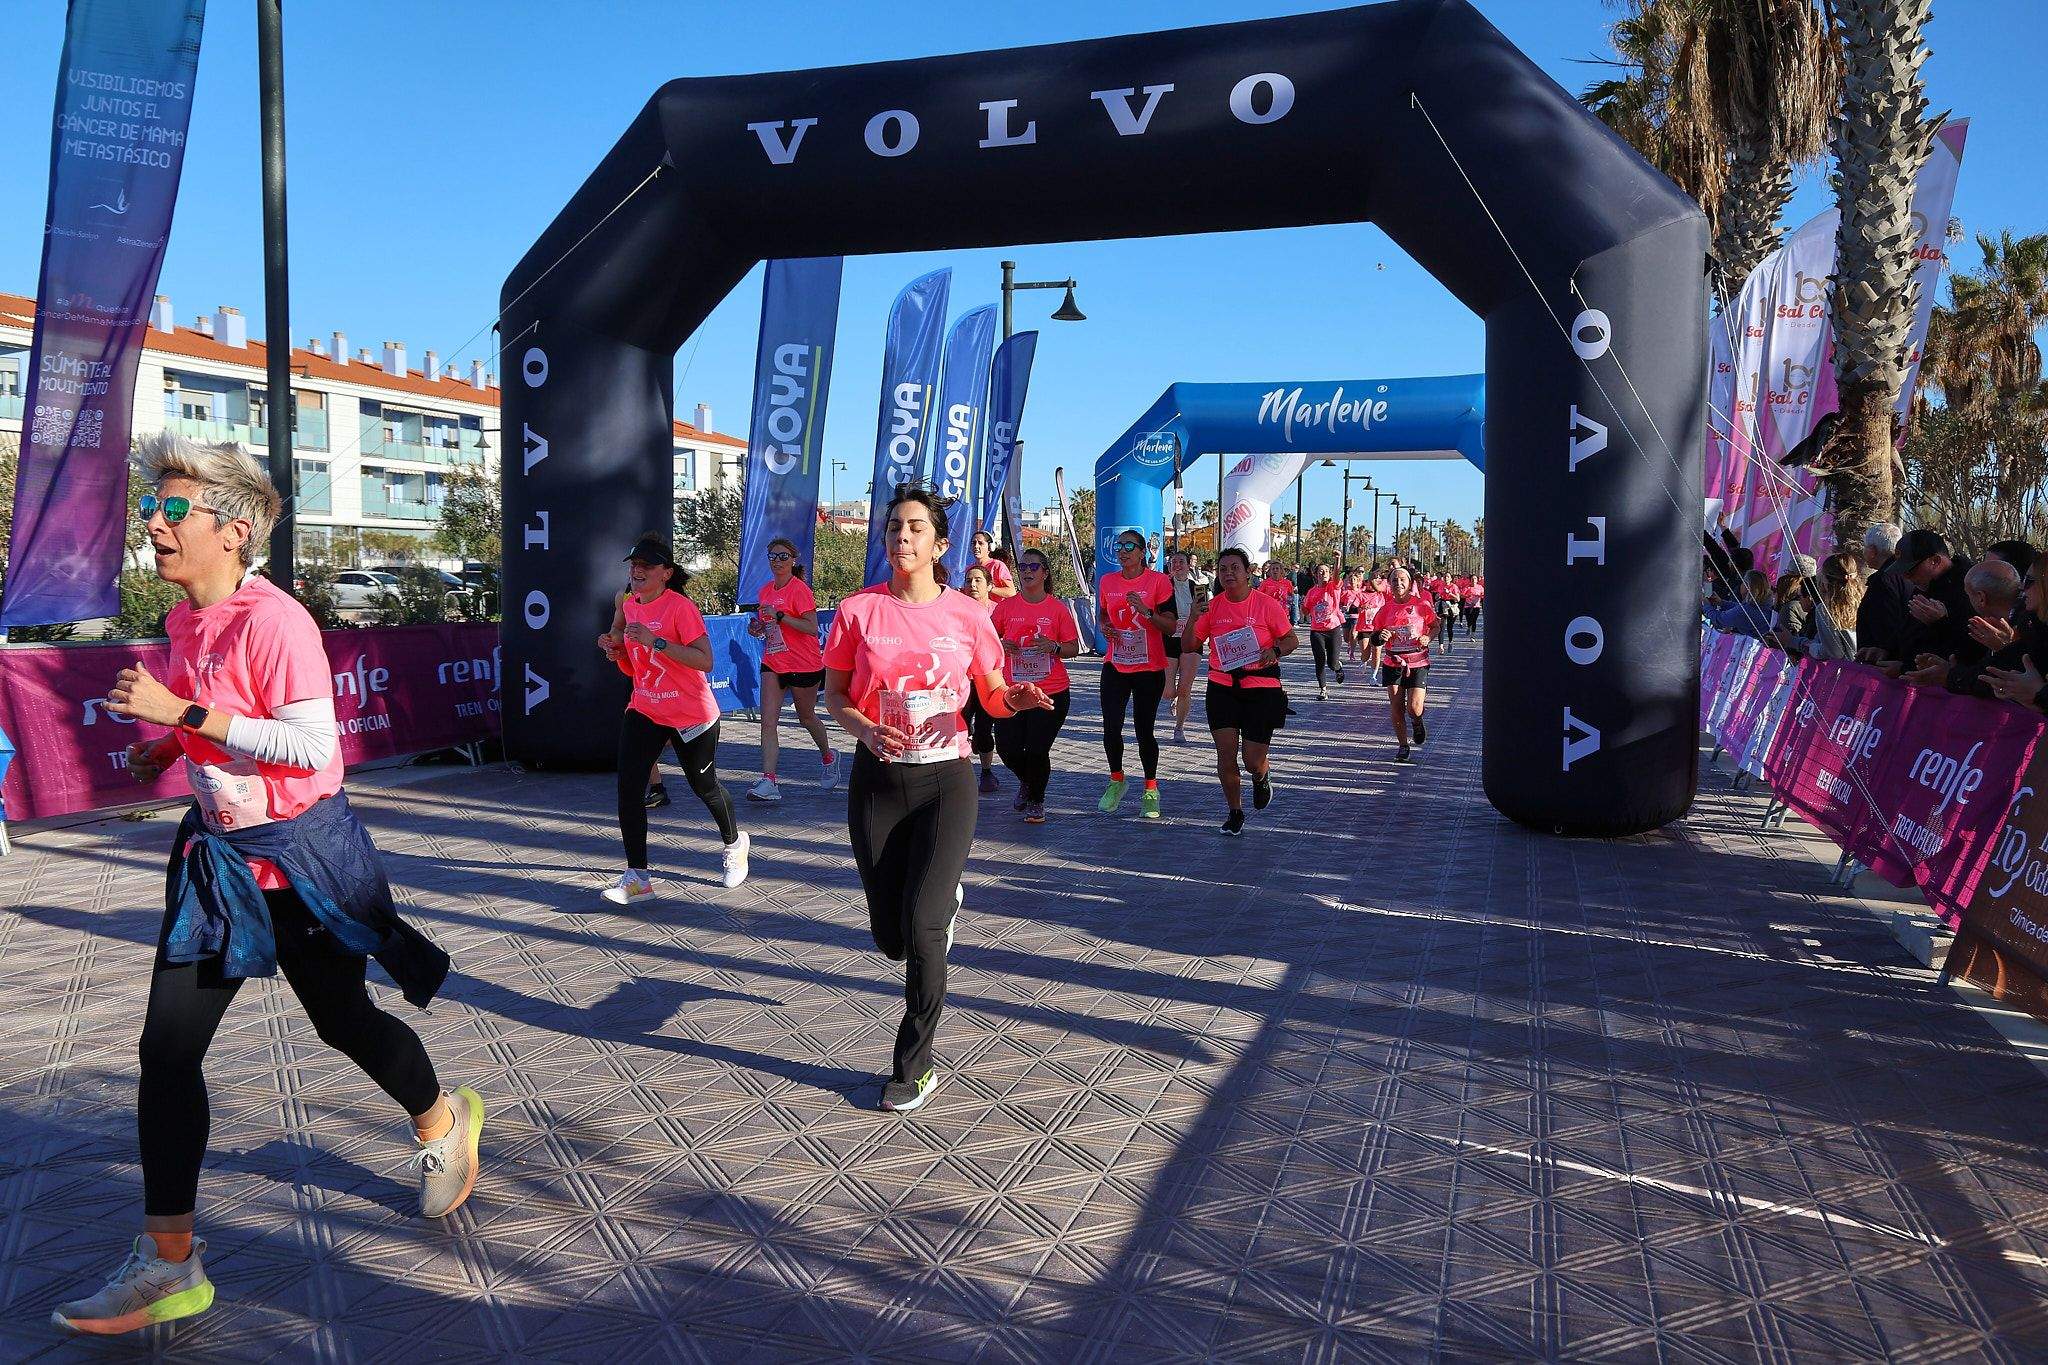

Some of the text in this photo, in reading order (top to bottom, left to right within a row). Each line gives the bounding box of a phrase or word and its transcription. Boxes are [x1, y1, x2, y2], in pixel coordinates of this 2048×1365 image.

[67, 68, 187, 100] VISIBILICEMOS
[80, 95, 161, 120] JUNTOS EL
[56, 111, 184, 147] CÁNCER DE MAMA
[747, 72, 1296, 166] VOLVO
[65, 138, 171, 169] METASTÁSICO
[38, 375, 109, 396] MOVIMIENTO
[41, 351, 101, 379] SÚMATE
[764, 343, 810, 476] GOYA
[887, 382, 922, 489] GOYA
[1258, 386, 1388, 444] Marlene
[942, 403, 971, 501] GOYA
[989, 421, 1012, 504] OYA
[522, 347, 550, 716] VOLVO
[1562, 308, 1612, 772] VOLVO
[334, 654, 390, 709] nfe
[438, 643, 502, 693] renf
[455, 701, 484, 718] TREN
[1828, 706, 1883, 769] renfe
[1909, 741, 1984, 816] renfe
[1893, 813, 1915, 842] TREN
